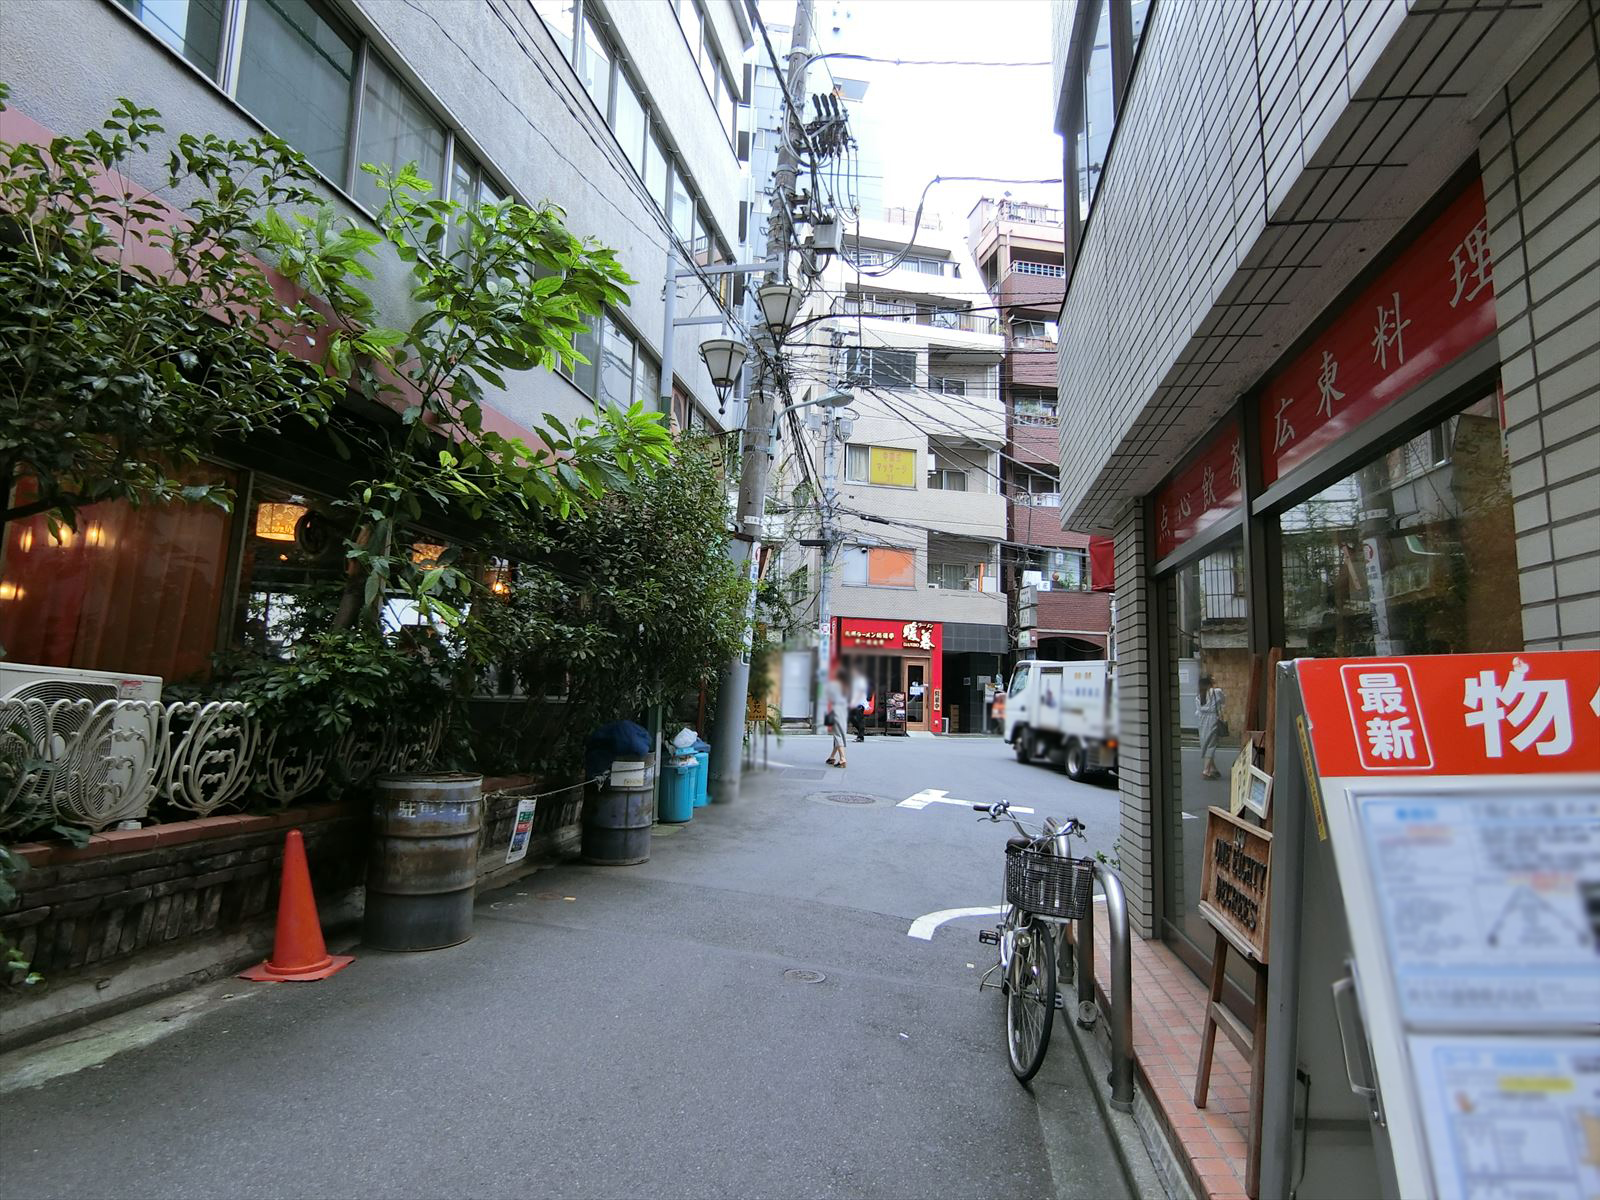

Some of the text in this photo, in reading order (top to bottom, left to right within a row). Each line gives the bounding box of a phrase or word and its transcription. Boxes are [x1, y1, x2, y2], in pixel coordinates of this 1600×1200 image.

[1271, 216, 1494, 457] 広東料理
[1357, 672, 1416, 761] 最新
[1463, 671, 1600, 759] 物
